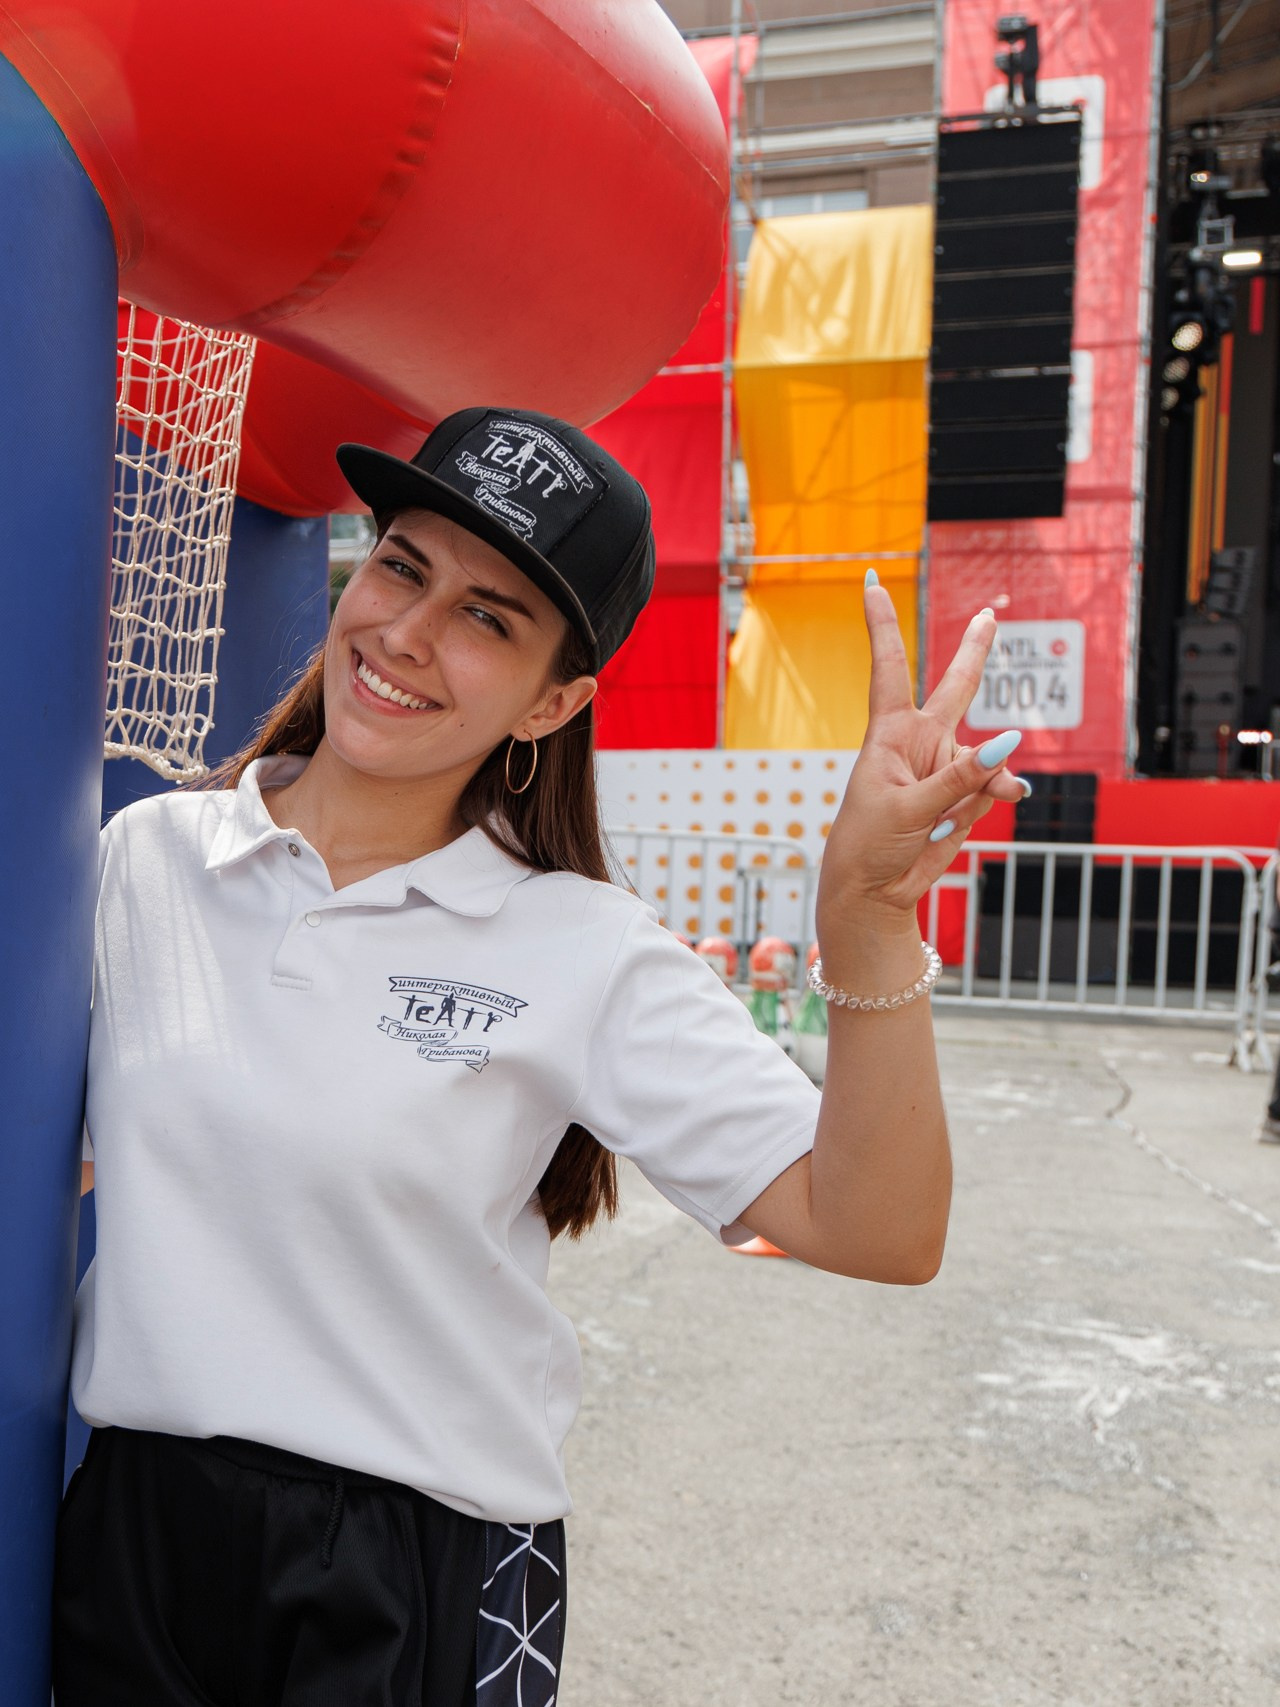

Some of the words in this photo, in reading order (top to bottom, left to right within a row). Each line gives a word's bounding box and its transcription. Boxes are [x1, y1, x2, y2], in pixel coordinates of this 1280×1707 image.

[493, 421, 586, 483] интерактивный
[462, 461, 512, 487] Николая
[477, 488, 532, 526] Грибанова
[983, 672, 1069, 712] 100.4
[397, 979, 517, 1010] интерактивный
[394, 1027, 447, 1041] Николая
[421, 1047, 482, 1057] Грибанова
